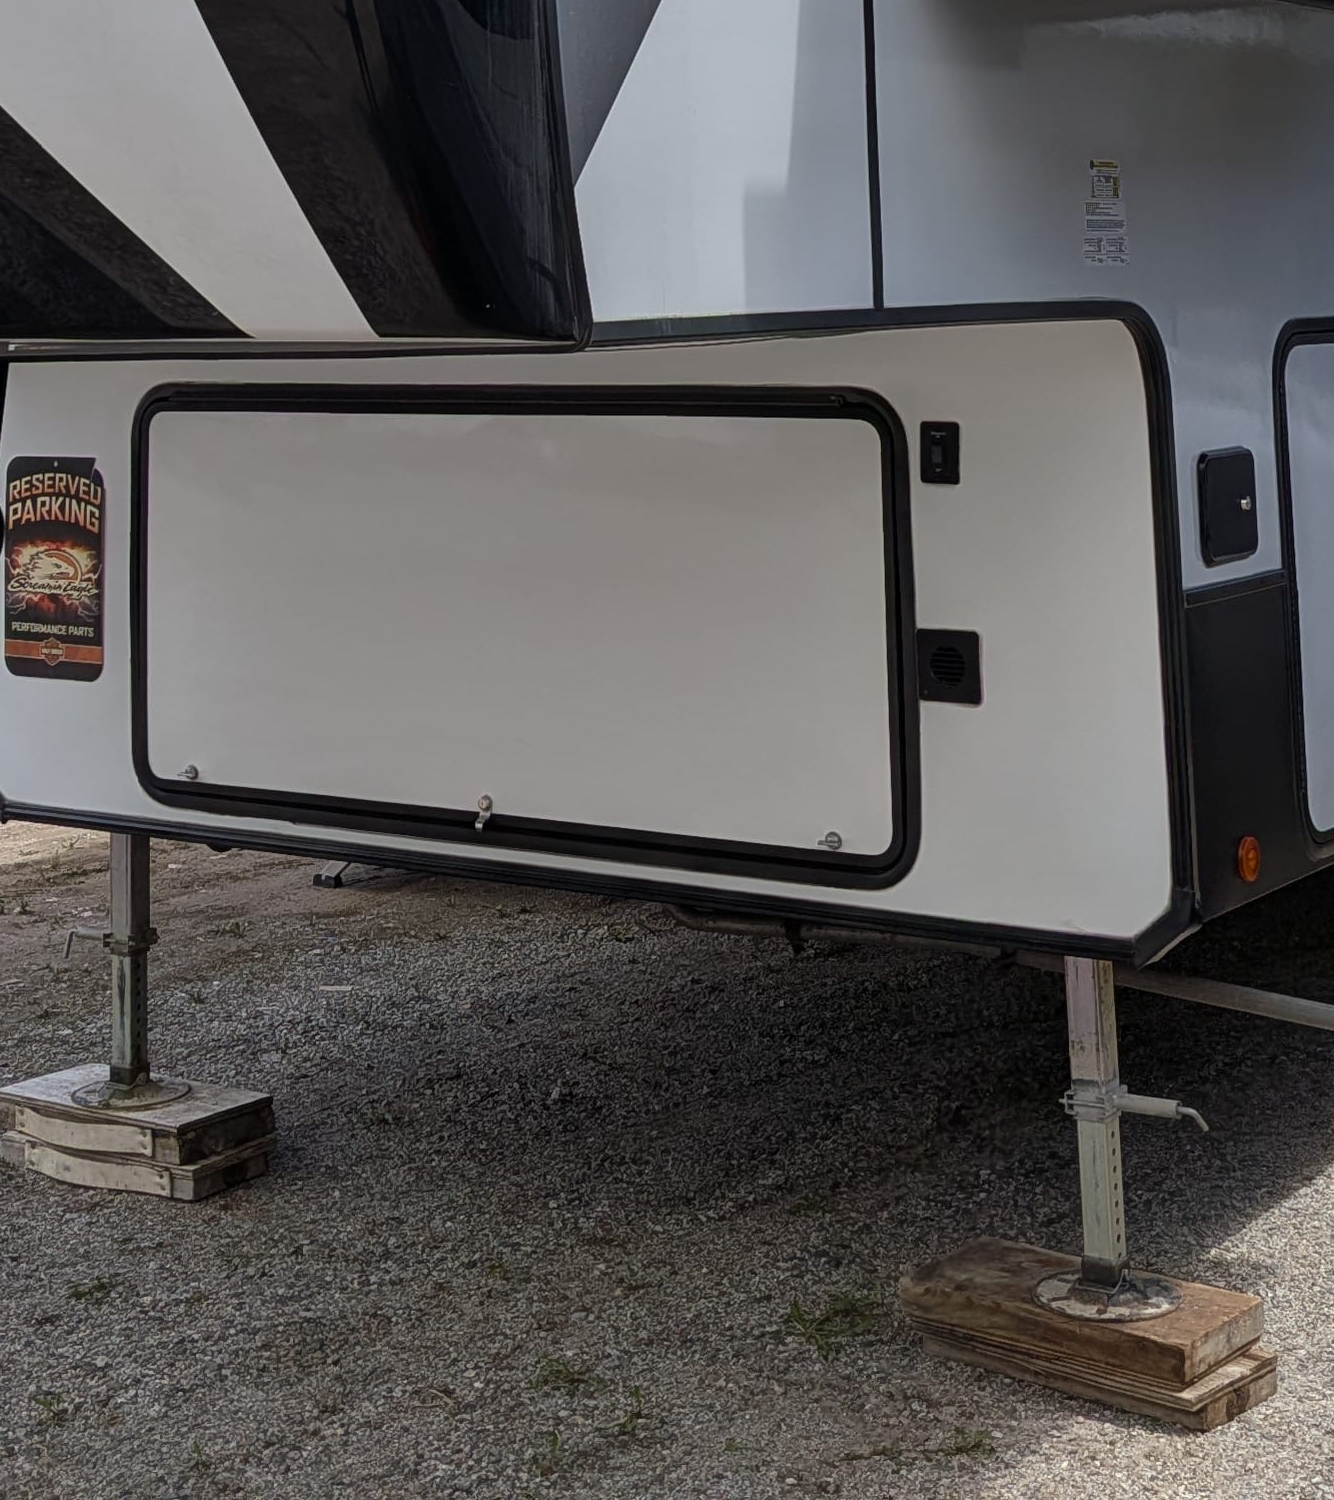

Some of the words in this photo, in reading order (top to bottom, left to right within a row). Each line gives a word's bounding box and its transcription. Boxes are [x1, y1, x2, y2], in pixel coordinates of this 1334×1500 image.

[9, 472, 102, 506] RESERVED
[8, 495, 100, 535] PARKING
[63, 580, 96, 598] Eagle
[11, 621, 67, 636] PERFORMANCE
[68, 626, 95, 638] PARTS
